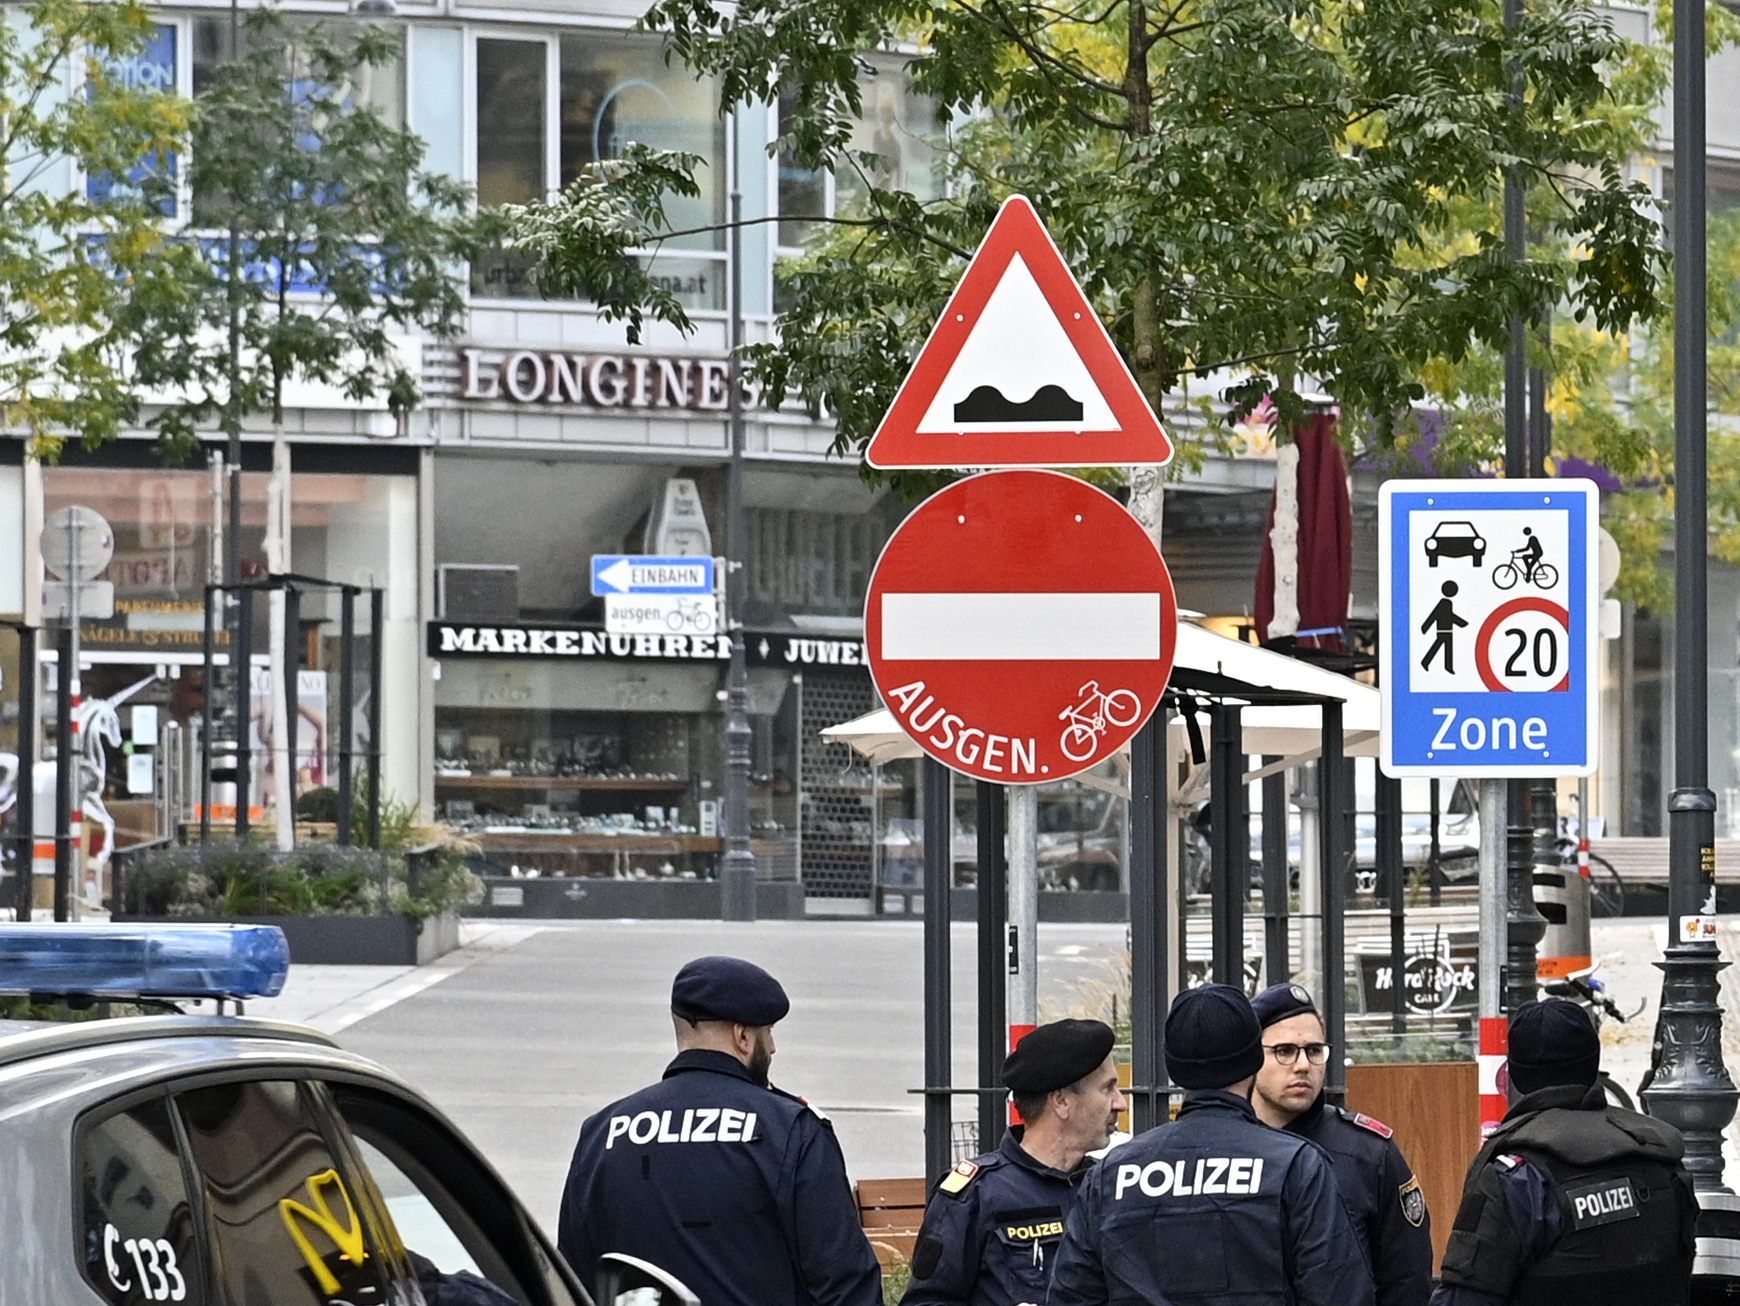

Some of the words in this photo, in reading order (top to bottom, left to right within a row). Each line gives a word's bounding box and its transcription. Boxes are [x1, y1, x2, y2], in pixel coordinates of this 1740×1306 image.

[631, 568, 699, 584] EINBAHN
[440, 627, 733, 660] MARKENUHREN
[1505, 628, 1558, 678] 20
[888, 680, 1049, 774] AUSGEN.
[1431, 708, 1548, 750] Zone
[1375, 966, 1427, 990] Hrd
[605, 1108, 758, 1150] POLIZEI
[1115, 1158, 1264, 1200] POLIZEI
[1576, 1186, 1635, 1220] POLIZEI
[1007, 1221, 1063, 1240] POLIZEI
[124, 1238, 187, 1301] 133
